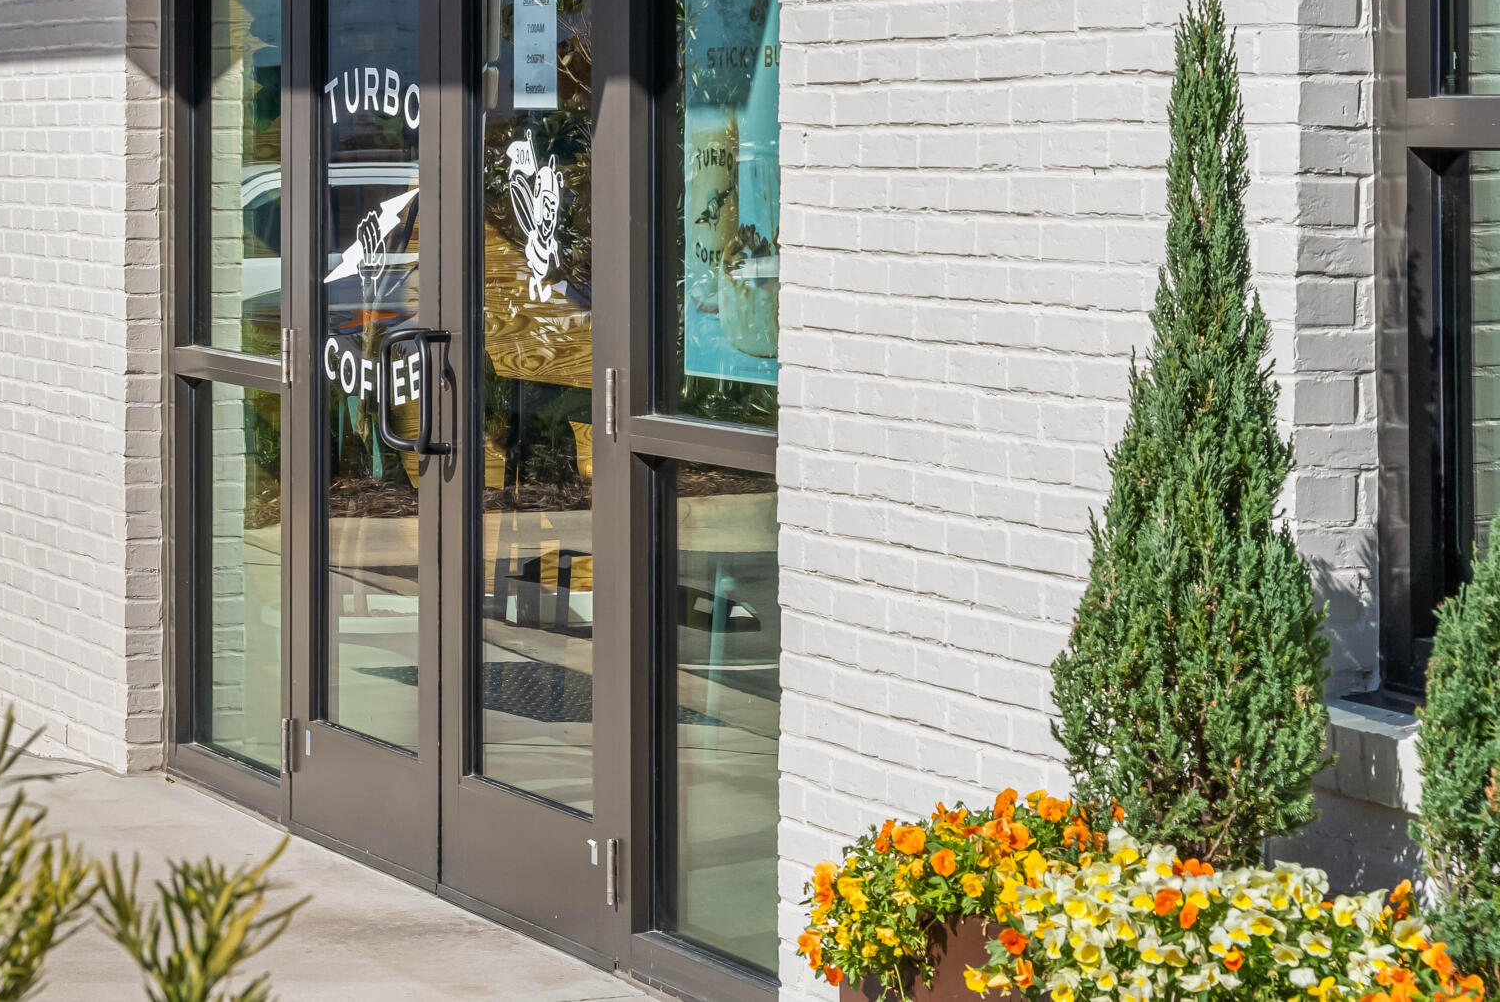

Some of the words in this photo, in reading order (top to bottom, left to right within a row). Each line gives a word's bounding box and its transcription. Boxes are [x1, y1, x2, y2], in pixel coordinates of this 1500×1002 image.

[706, 48, 759, 69] STICKY
[764, 45, 780, 67] BU
[324, 67, 420, 129] TURBO
[515, 148, 531, 165] 30A
[696, 148, 734, 171] TURBO
[324, 337, 420, 406] COFEE
